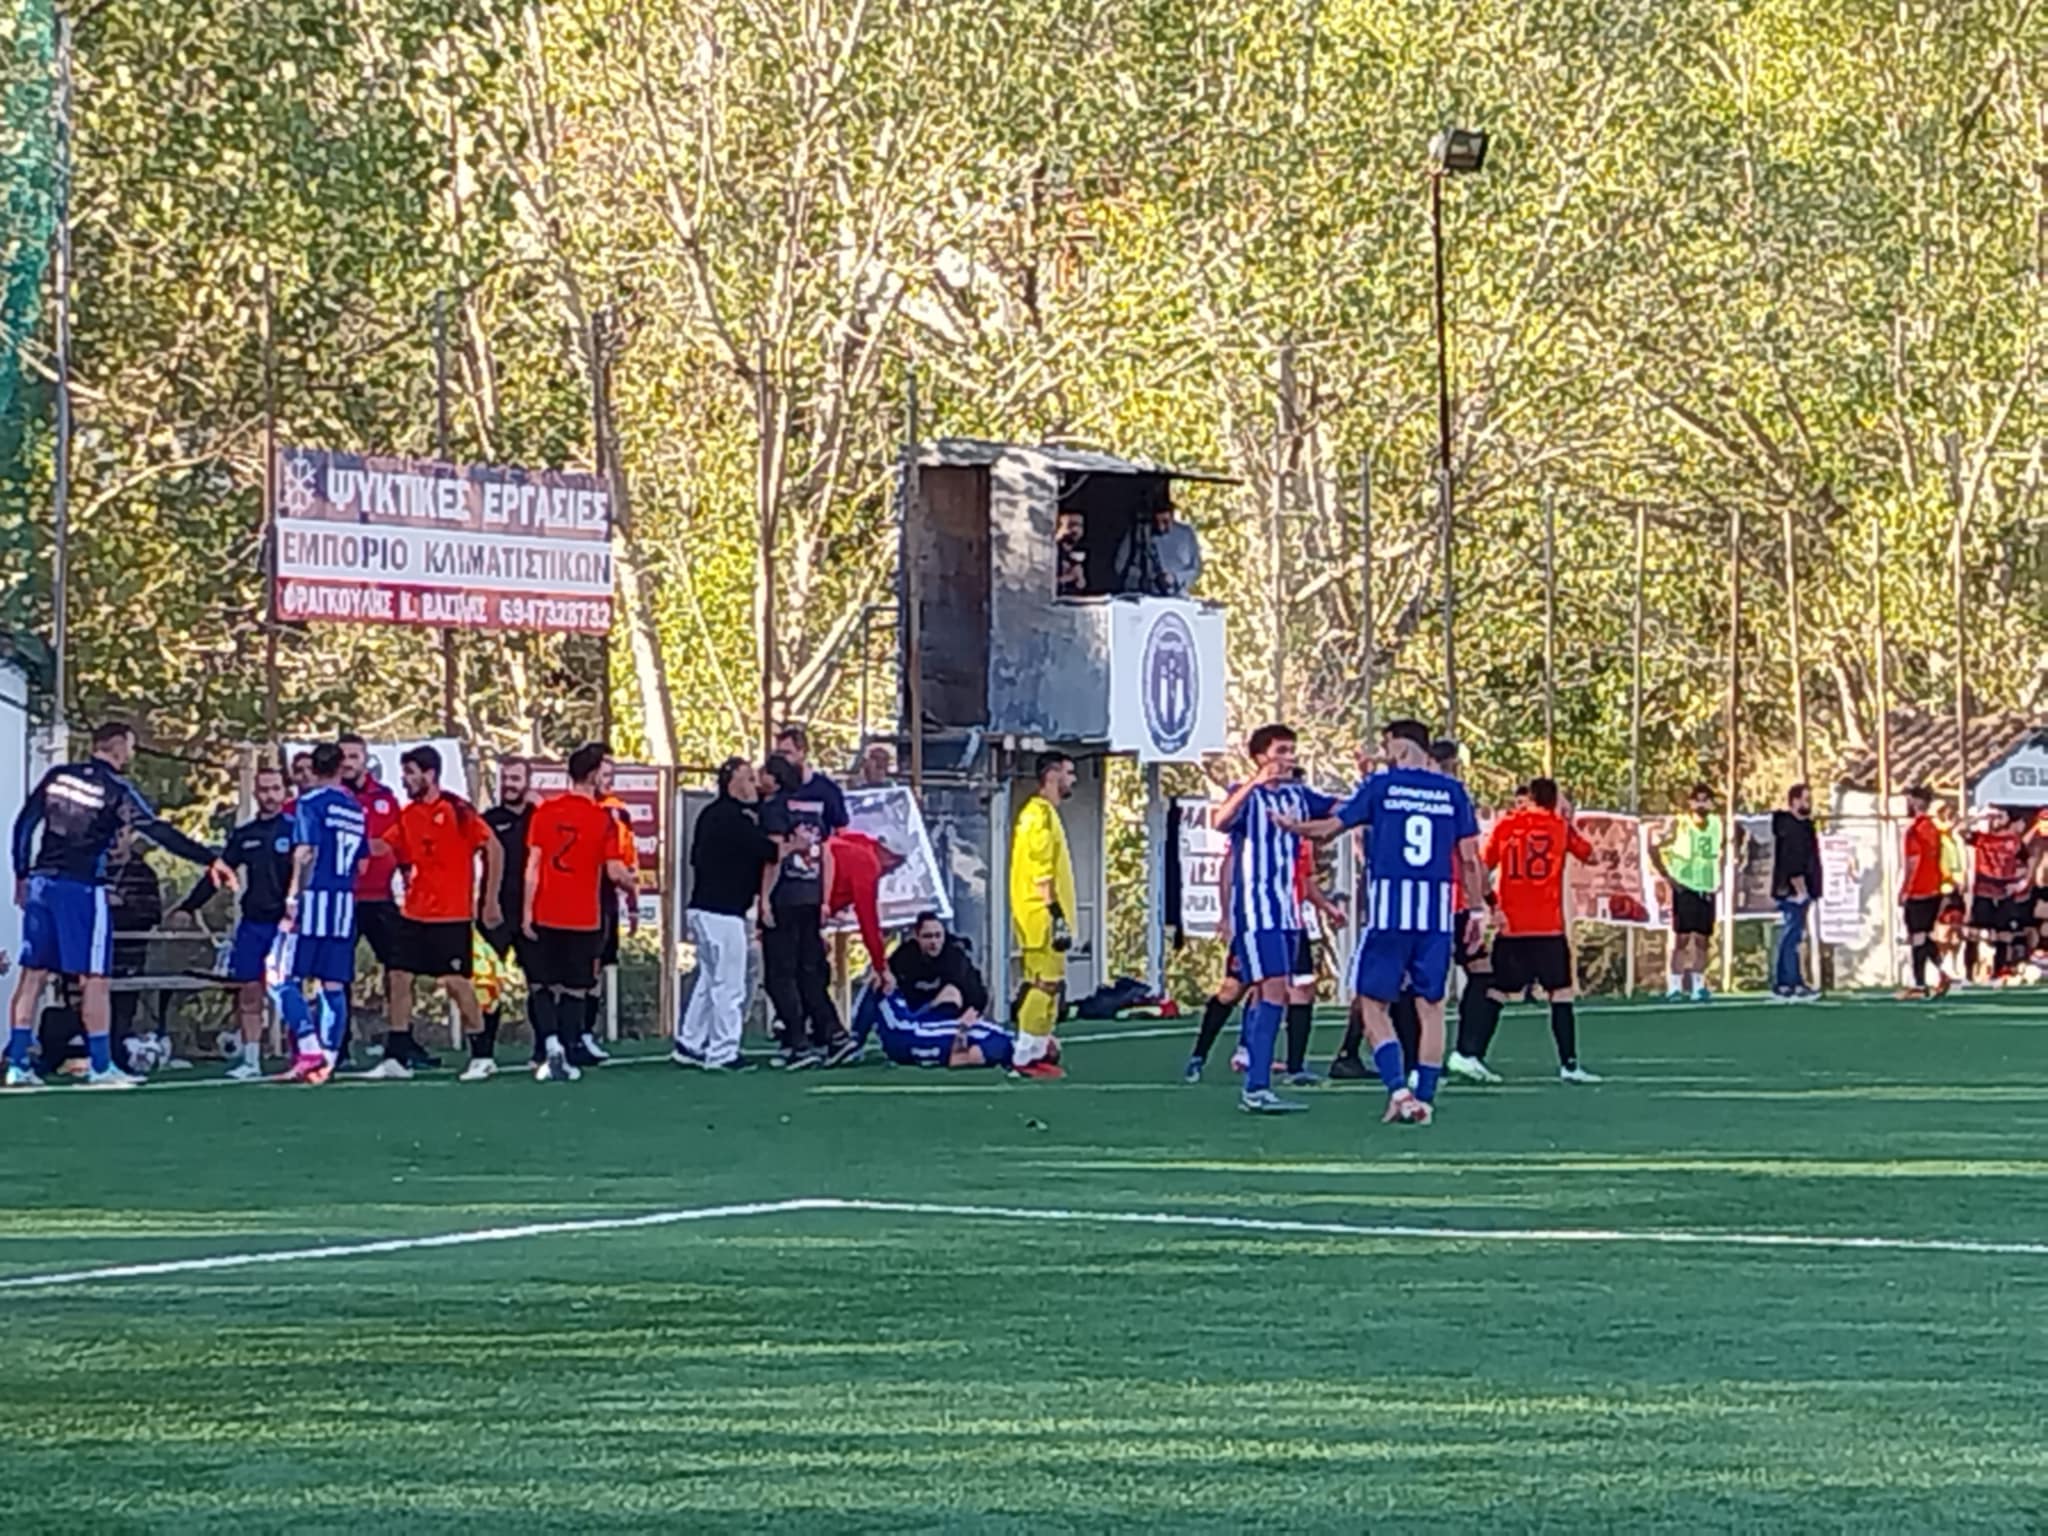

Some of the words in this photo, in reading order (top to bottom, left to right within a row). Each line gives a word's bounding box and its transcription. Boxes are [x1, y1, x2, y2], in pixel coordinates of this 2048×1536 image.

[326, 467, 471, 521] ΨΥΚΤΙΚΕΣ
[482, 481, 609, 532] ΕΡΓΑΣΙΕΣ
[283, 531, 408, 570] ΕΜΠΟΡΙΟ
[424, 540, 611, 584] ΚΛΙΜΑΤΙΣΤΙΚΩΝ
[335, 830, 362, 877] 17
[552, 824, 577, 873] 2
[1403, 814, 1432, 867] 9
[1505, 834, 1554, 880] 18
